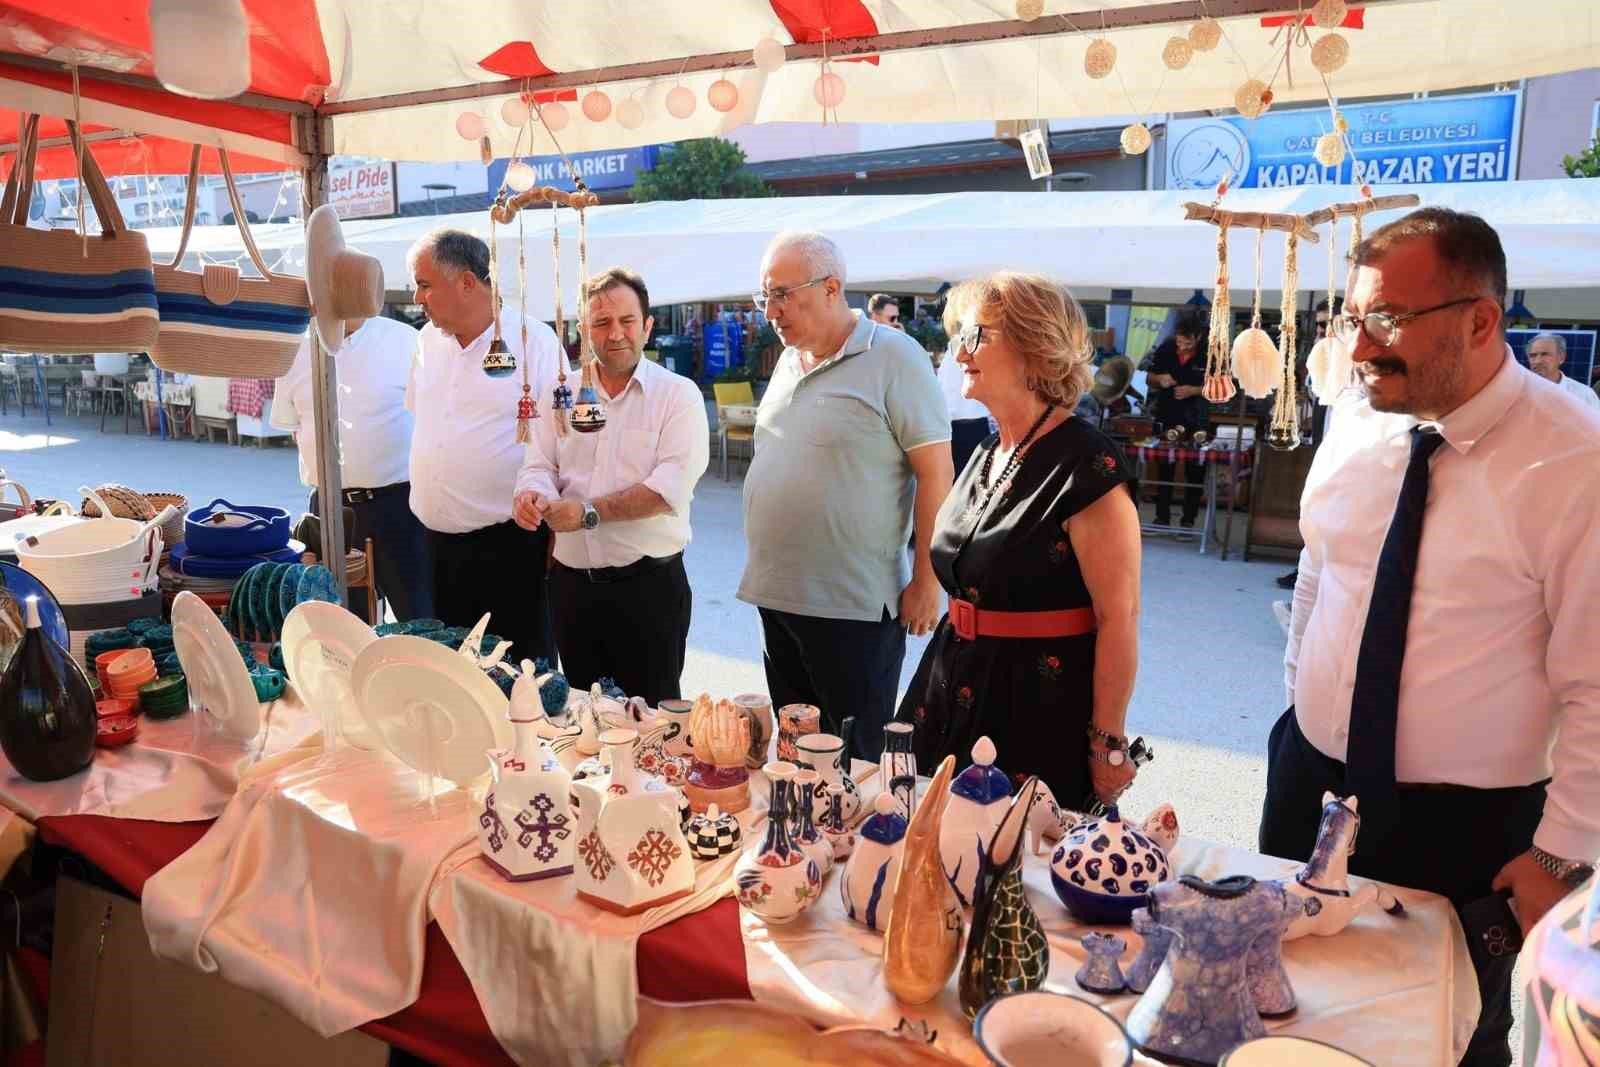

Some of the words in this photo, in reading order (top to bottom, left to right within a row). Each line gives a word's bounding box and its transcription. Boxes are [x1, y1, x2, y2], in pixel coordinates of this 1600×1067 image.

[328, 170, 352, 192] sel
[356, 166, 388, 189] Pide
[558, 154, 627, 179] MARKET
[1258, 163, 1342, 188] KAPALI
[1352, 156, 1434, 184] PAZAR
[1443, 144, 1506, 181] YERİ
